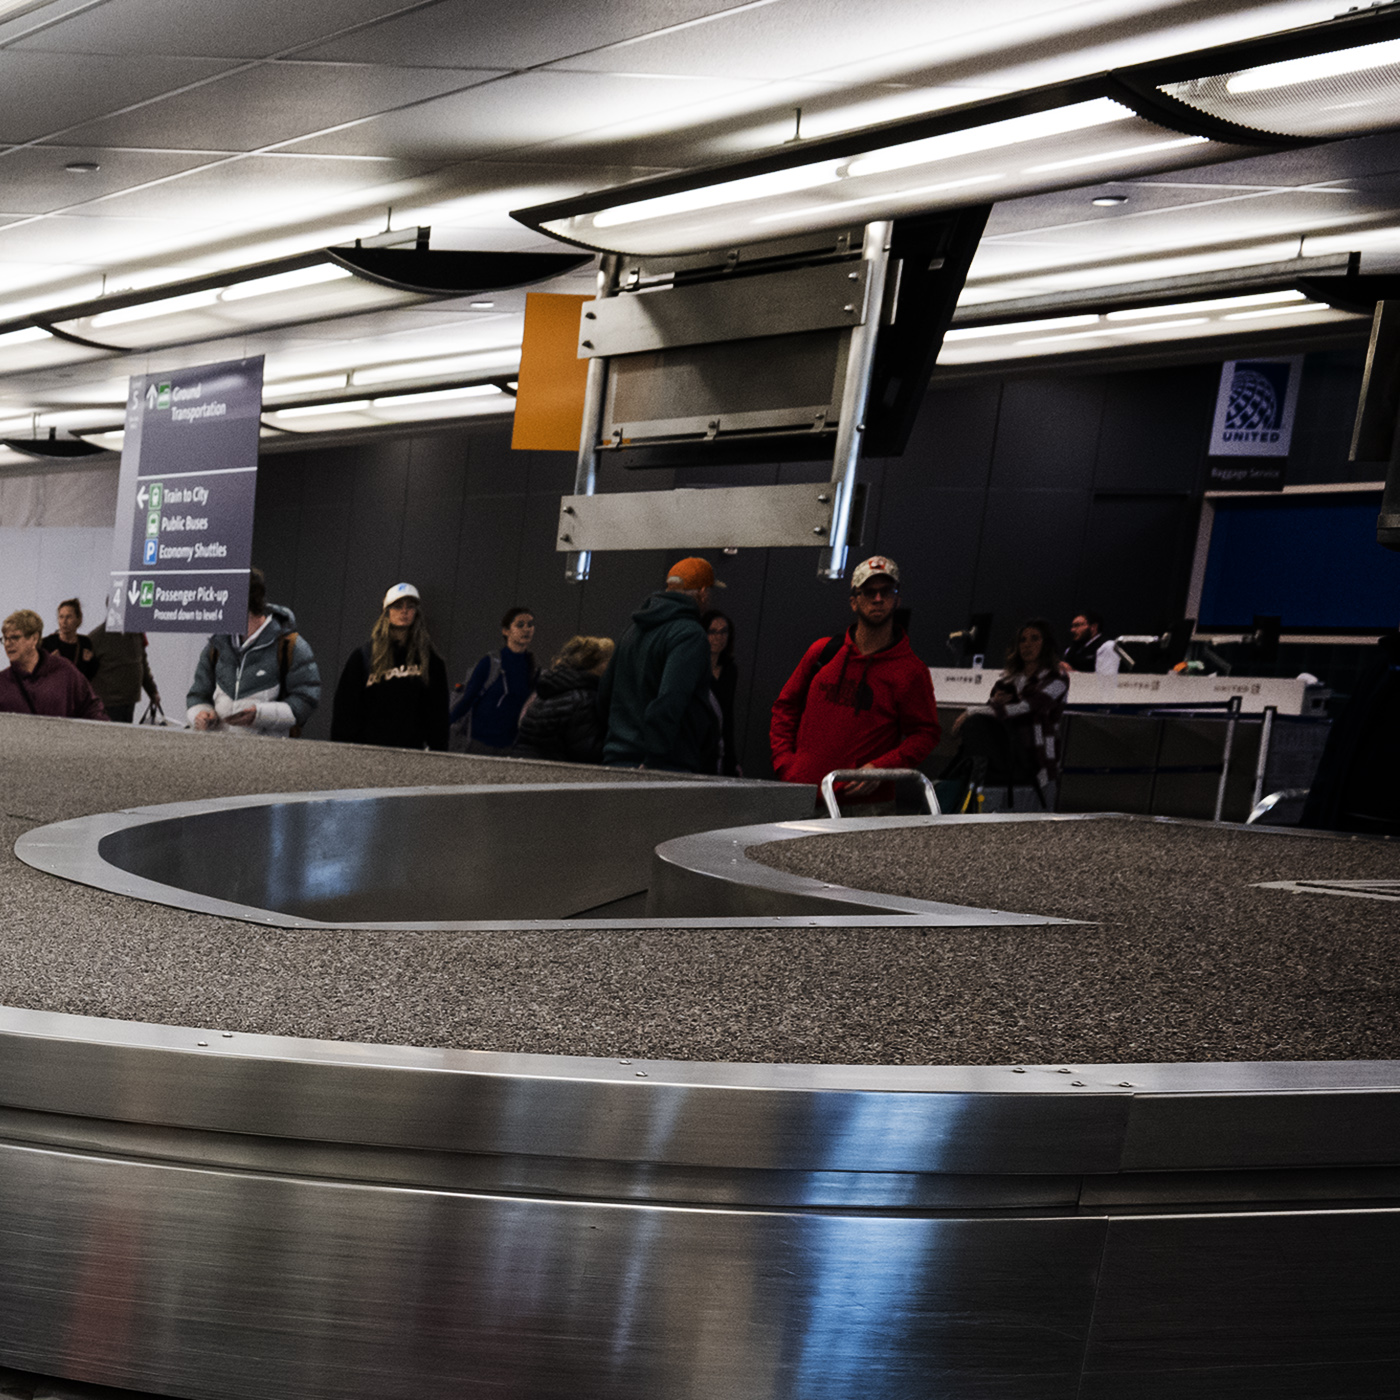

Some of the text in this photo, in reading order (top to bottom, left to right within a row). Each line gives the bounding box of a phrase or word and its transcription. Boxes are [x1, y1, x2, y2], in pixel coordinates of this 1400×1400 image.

[172, 382, 202, 402] Ground
[171, 401, 227, 424] Transportation
[1223, 432, 1280, 443] UNITED
[163, 486, 210, 506] Train to City
[161, 515, 209, 532] Public Buses
[159, 542, 228, 562] Economy Shuttles
[113, 588, 121, 607] 4
[155, 586, 229, 606] Passenger Pick-up
